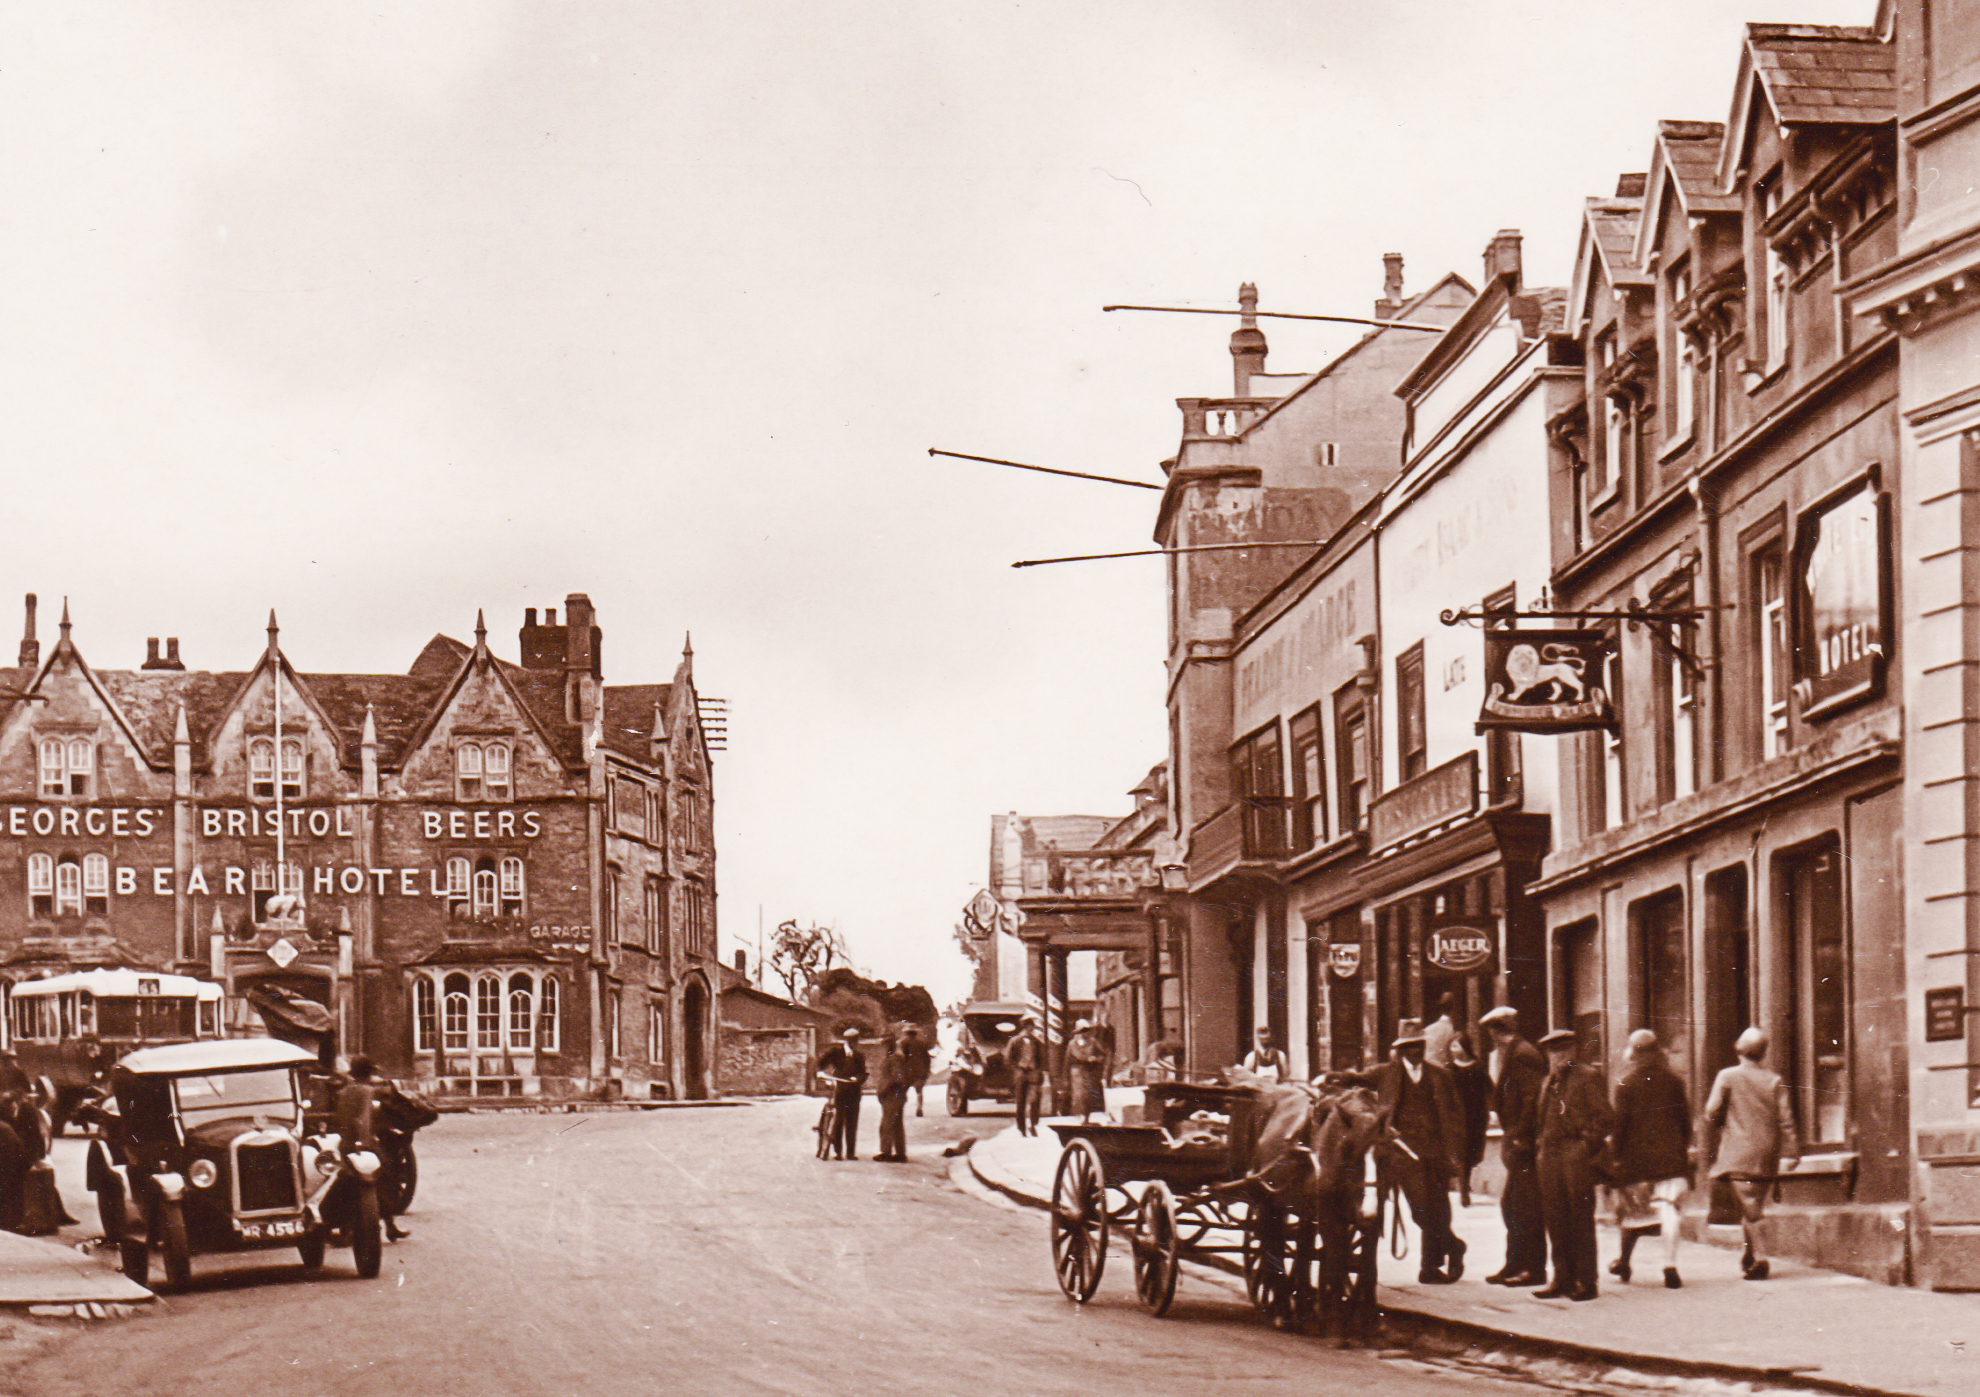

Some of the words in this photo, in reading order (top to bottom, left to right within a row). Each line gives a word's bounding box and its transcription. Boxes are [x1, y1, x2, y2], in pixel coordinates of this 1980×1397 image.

[0, 806, 163, 837] EORGES'
[203, 808, 353, 837] BRISTOL
[423, 810, 541, 839] BEERS
[115, 866, 246, 896] BEAR
[313, 866, 449, 896] HOTEL
[529, 924, 592, 940] GARAGE
[1427, 934, 1491, 962] JAEGER
